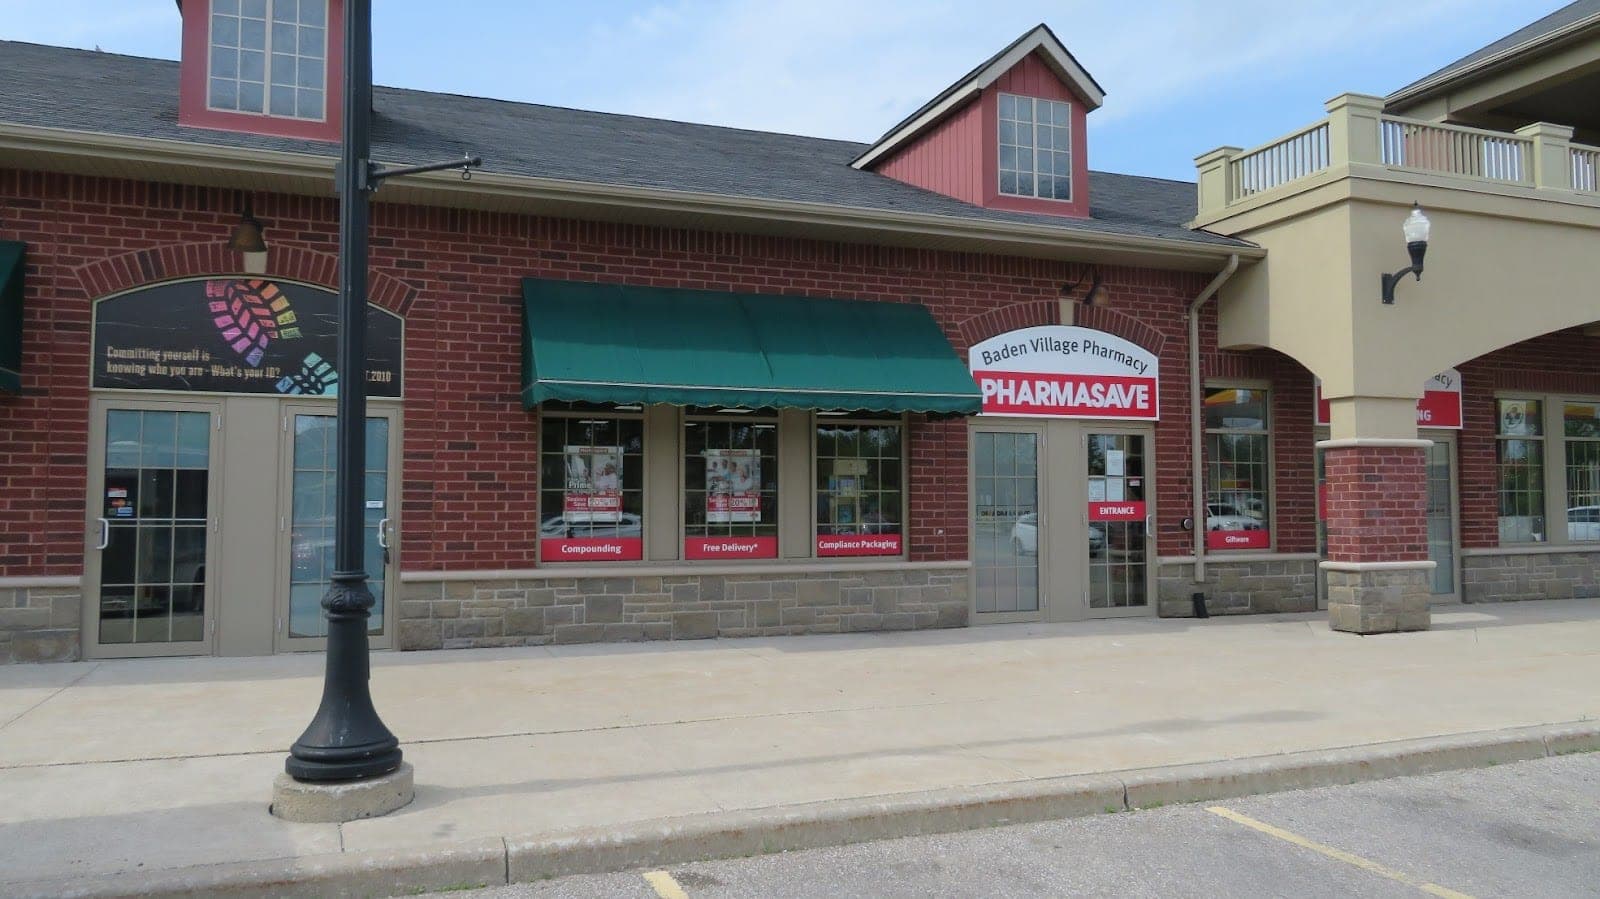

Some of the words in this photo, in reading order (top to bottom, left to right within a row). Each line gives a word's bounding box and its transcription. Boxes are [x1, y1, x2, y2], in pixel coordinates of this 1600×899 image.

[107, 346, 160, 360] Committing
[162, 349, 199, 362] yourself
[201, 350, 210, 361] is
[981, 342, 1028, 366] Baden
[1030, 336, 1079, 356] Village
[1083, 340, 1148, 375] Pharmacy
[107, 362, 145, 375] knowing
[148, 363, 168, 374] who
[170, 366, 186, 377] you
[188, 367, 203, 376] are
[211, 365, 242, 377] What's
[244, 368, 264, 380] your
[1434, 373, 1453, 389] acy
[980, 378, 1149, 409] PHARMASAVE
[1416, 409, 1432, 421] NG
[1099, 506, 1135, 515] ENTRANCE
[561, 543, 622, 554] Compounding
[703, 543, 722, 552] Free
[818, 540, 860, 551] Compliance
[861, 539, 897, 550] Packaging
